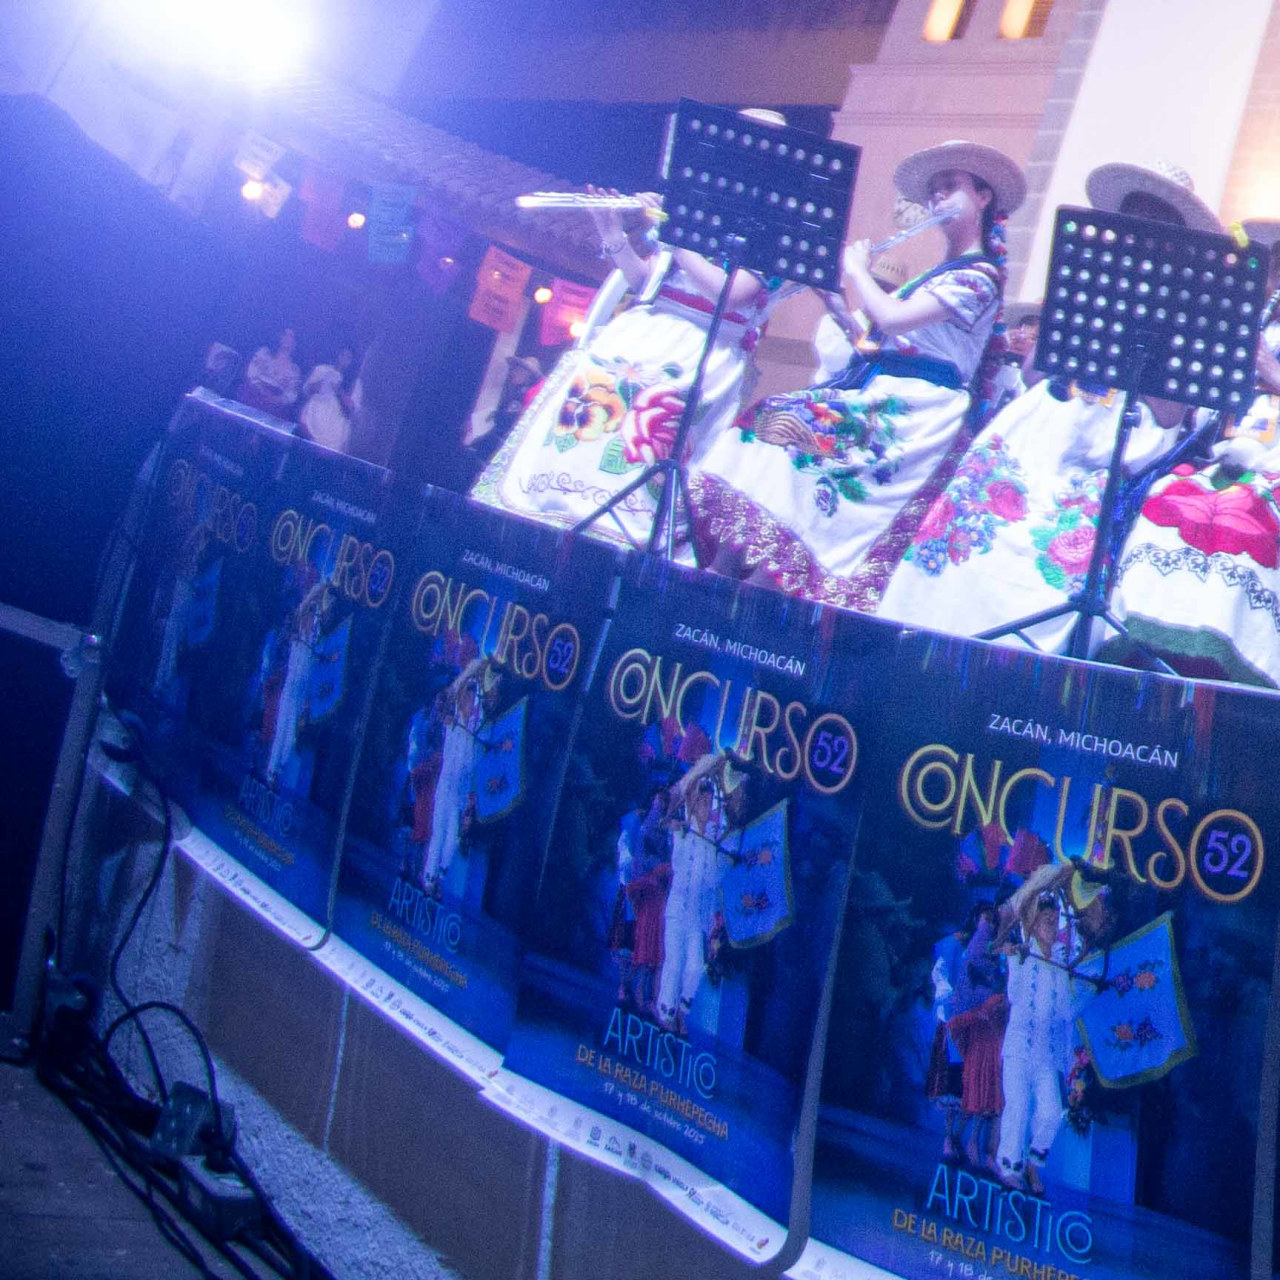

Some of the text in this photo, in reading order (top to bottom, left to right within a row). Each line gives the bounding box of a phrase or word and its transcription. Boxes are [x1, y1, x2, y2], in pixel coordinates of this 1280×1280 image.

[493, 562, 551, 593] MICHOACÁN
[548, 638, 575, 675] 52
[675, 623, 806, 677] ZACÁN, MICHOACÁN
[813, 730, 849, 775] 52
[989, 713, 1179, 769] ZACÁN, MICHOACÁN
[1203, 829, 1253, 878] 52
[575, 1043, 597, 1070] DE
[597, 1052, 612, 1075] LA
[613, 1061, 648, 1093] RAZA
[603, 1081, 615, 1096] 17
[626, 1091, 638, 1106] 18
[892, 1208, 918, 1235] DE
[920, 1217, 938, 1244] LA
[940, 1226, 988, 1263] RAZA
[927, 1249, 943, 1265] 17
[947, 1262, 955, 1277] y
[958, 1262, 974, 1277] 18
